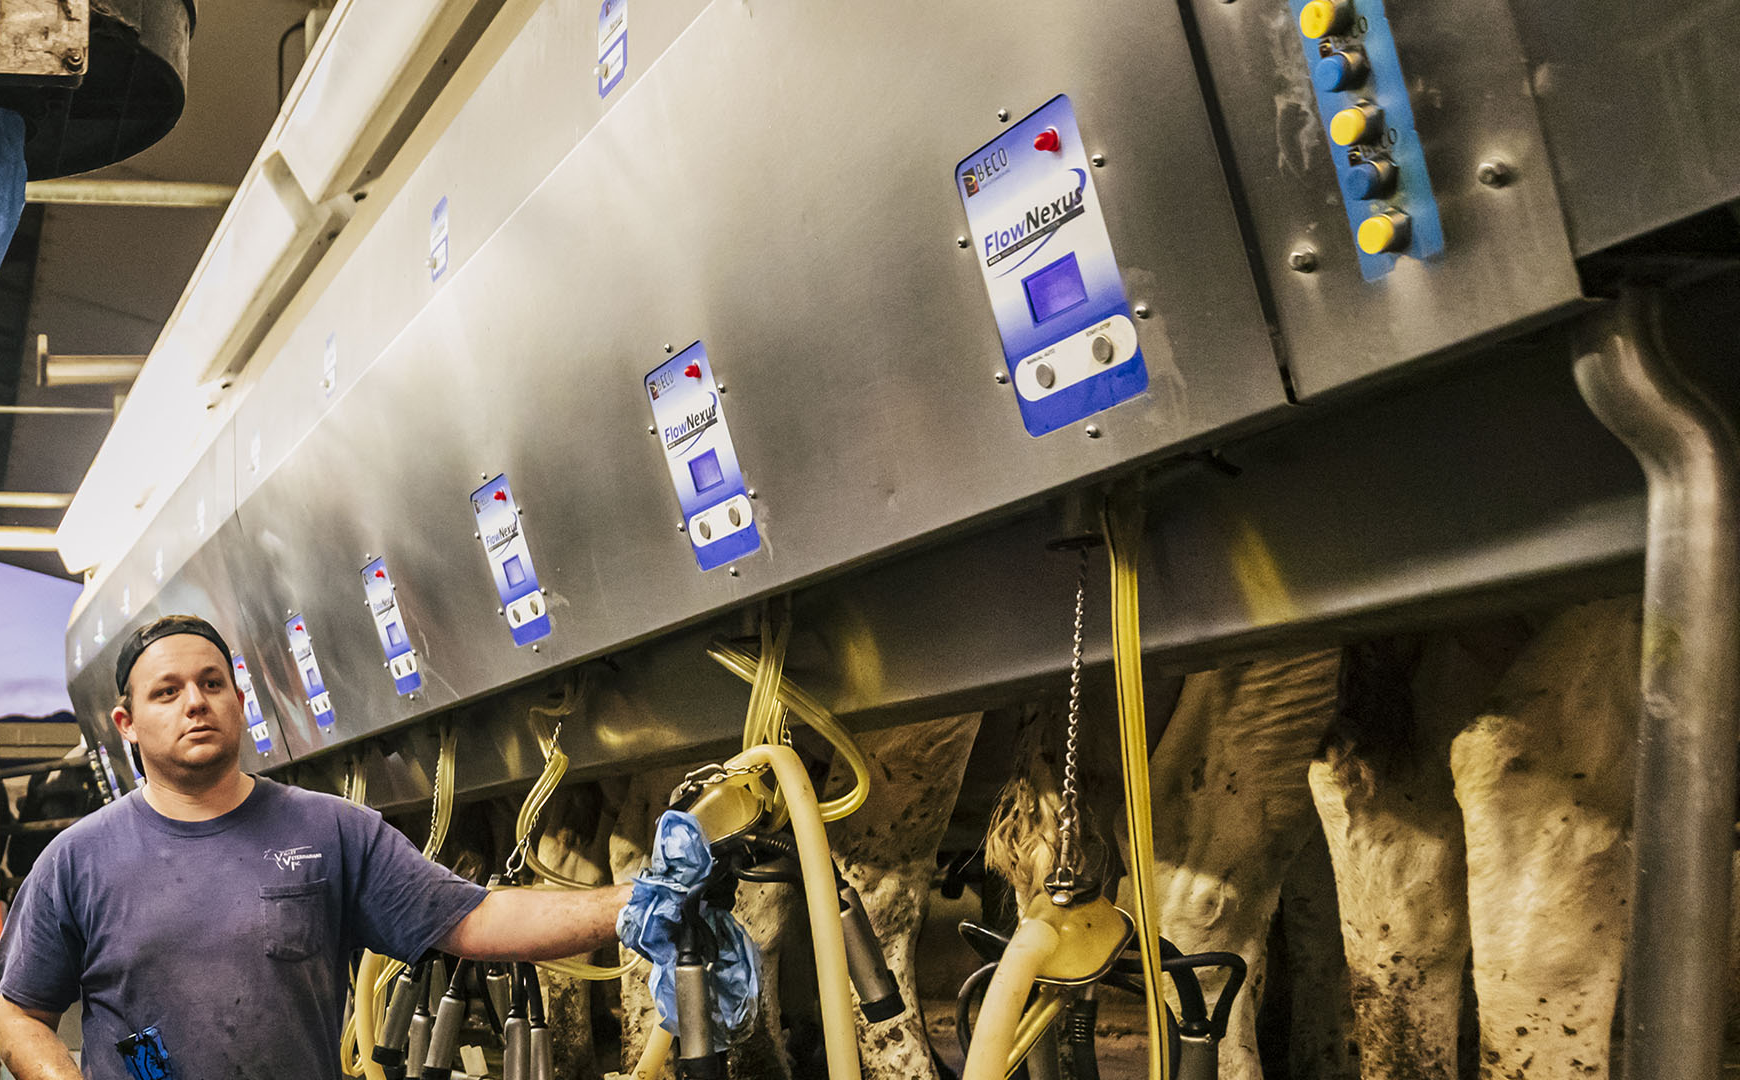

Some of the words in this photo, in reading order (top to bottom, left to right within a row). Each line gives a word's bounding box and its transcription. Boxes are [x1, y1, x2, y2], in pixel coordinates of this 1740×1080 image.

[976, 147, 1008, 182] BECO
[984, 187, 1083, 258] FlowNexus
[664, 404, 717, 444] FlowNexus
